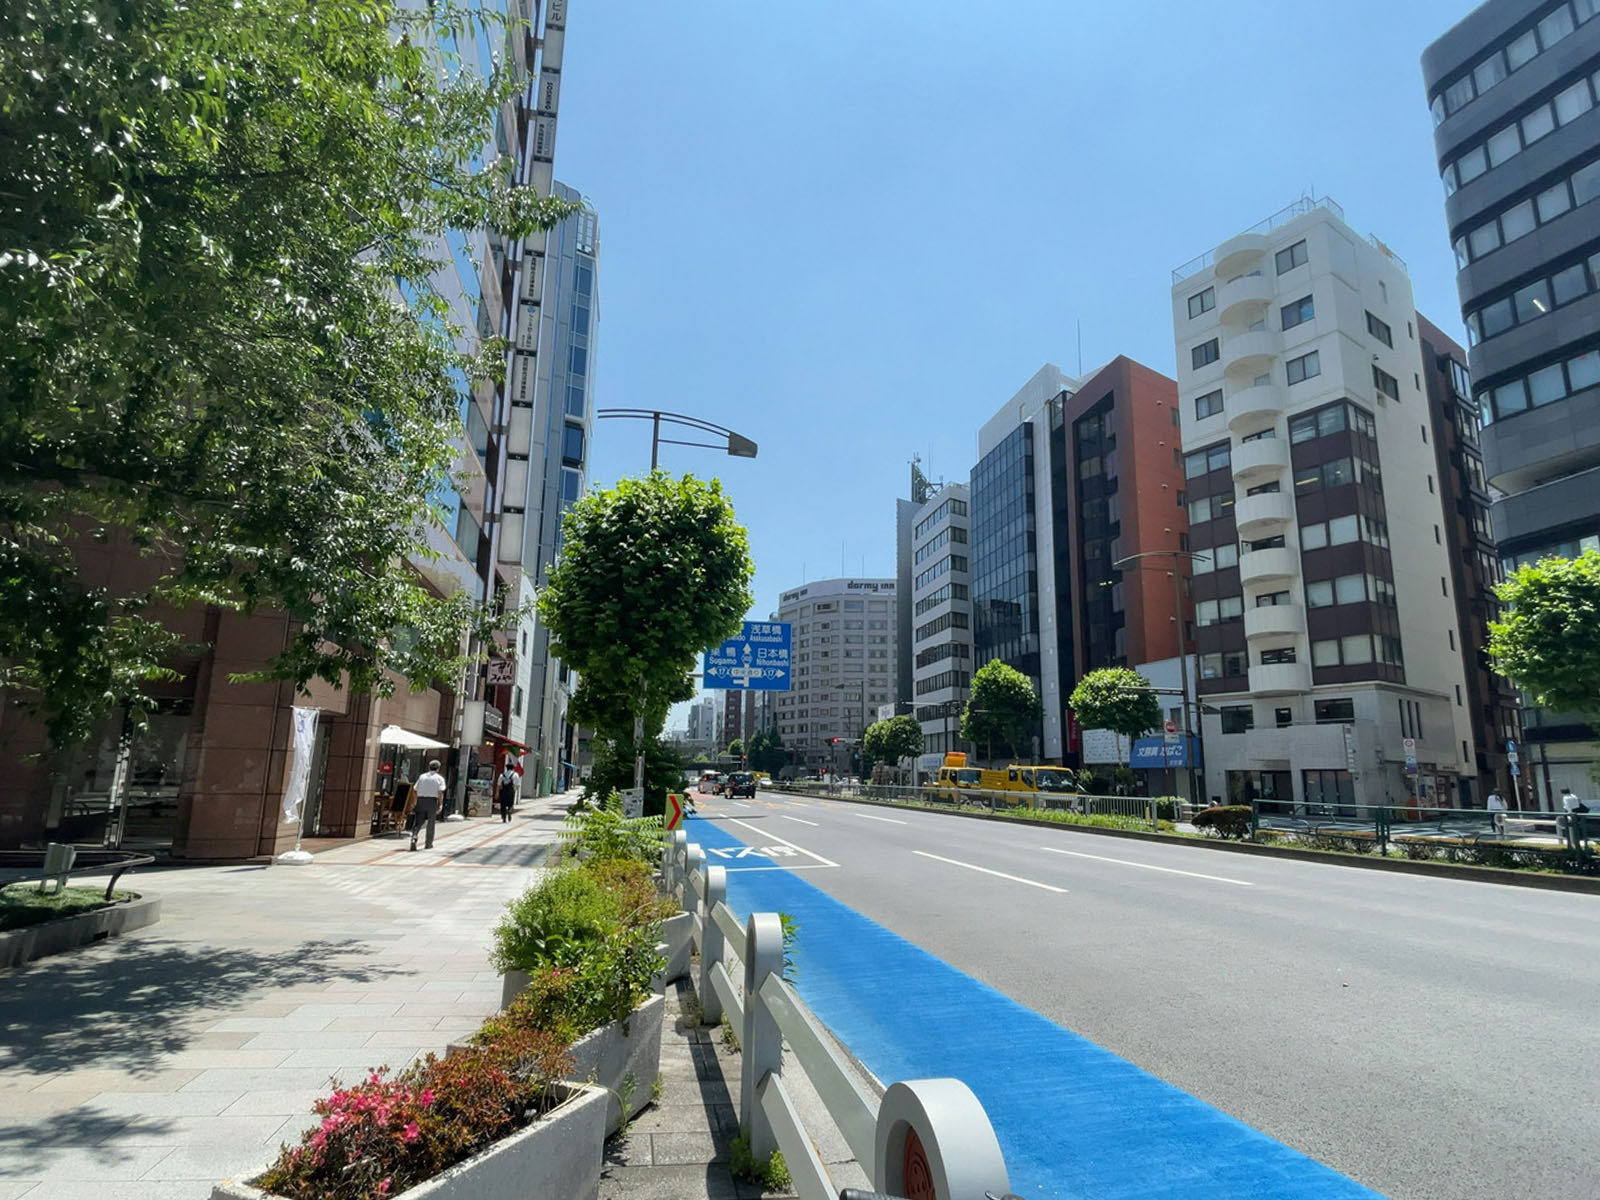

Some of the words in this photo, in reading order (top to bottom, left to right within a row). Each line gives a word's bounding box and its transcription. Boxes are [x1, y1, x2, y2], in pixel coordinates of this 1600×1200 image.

[847, 580, 878, 592] dormy
[881, 582, 895, 590] inn
[757, 648, 789, 659] 日本橋
[709, 656, 737, 665] Sugamo
